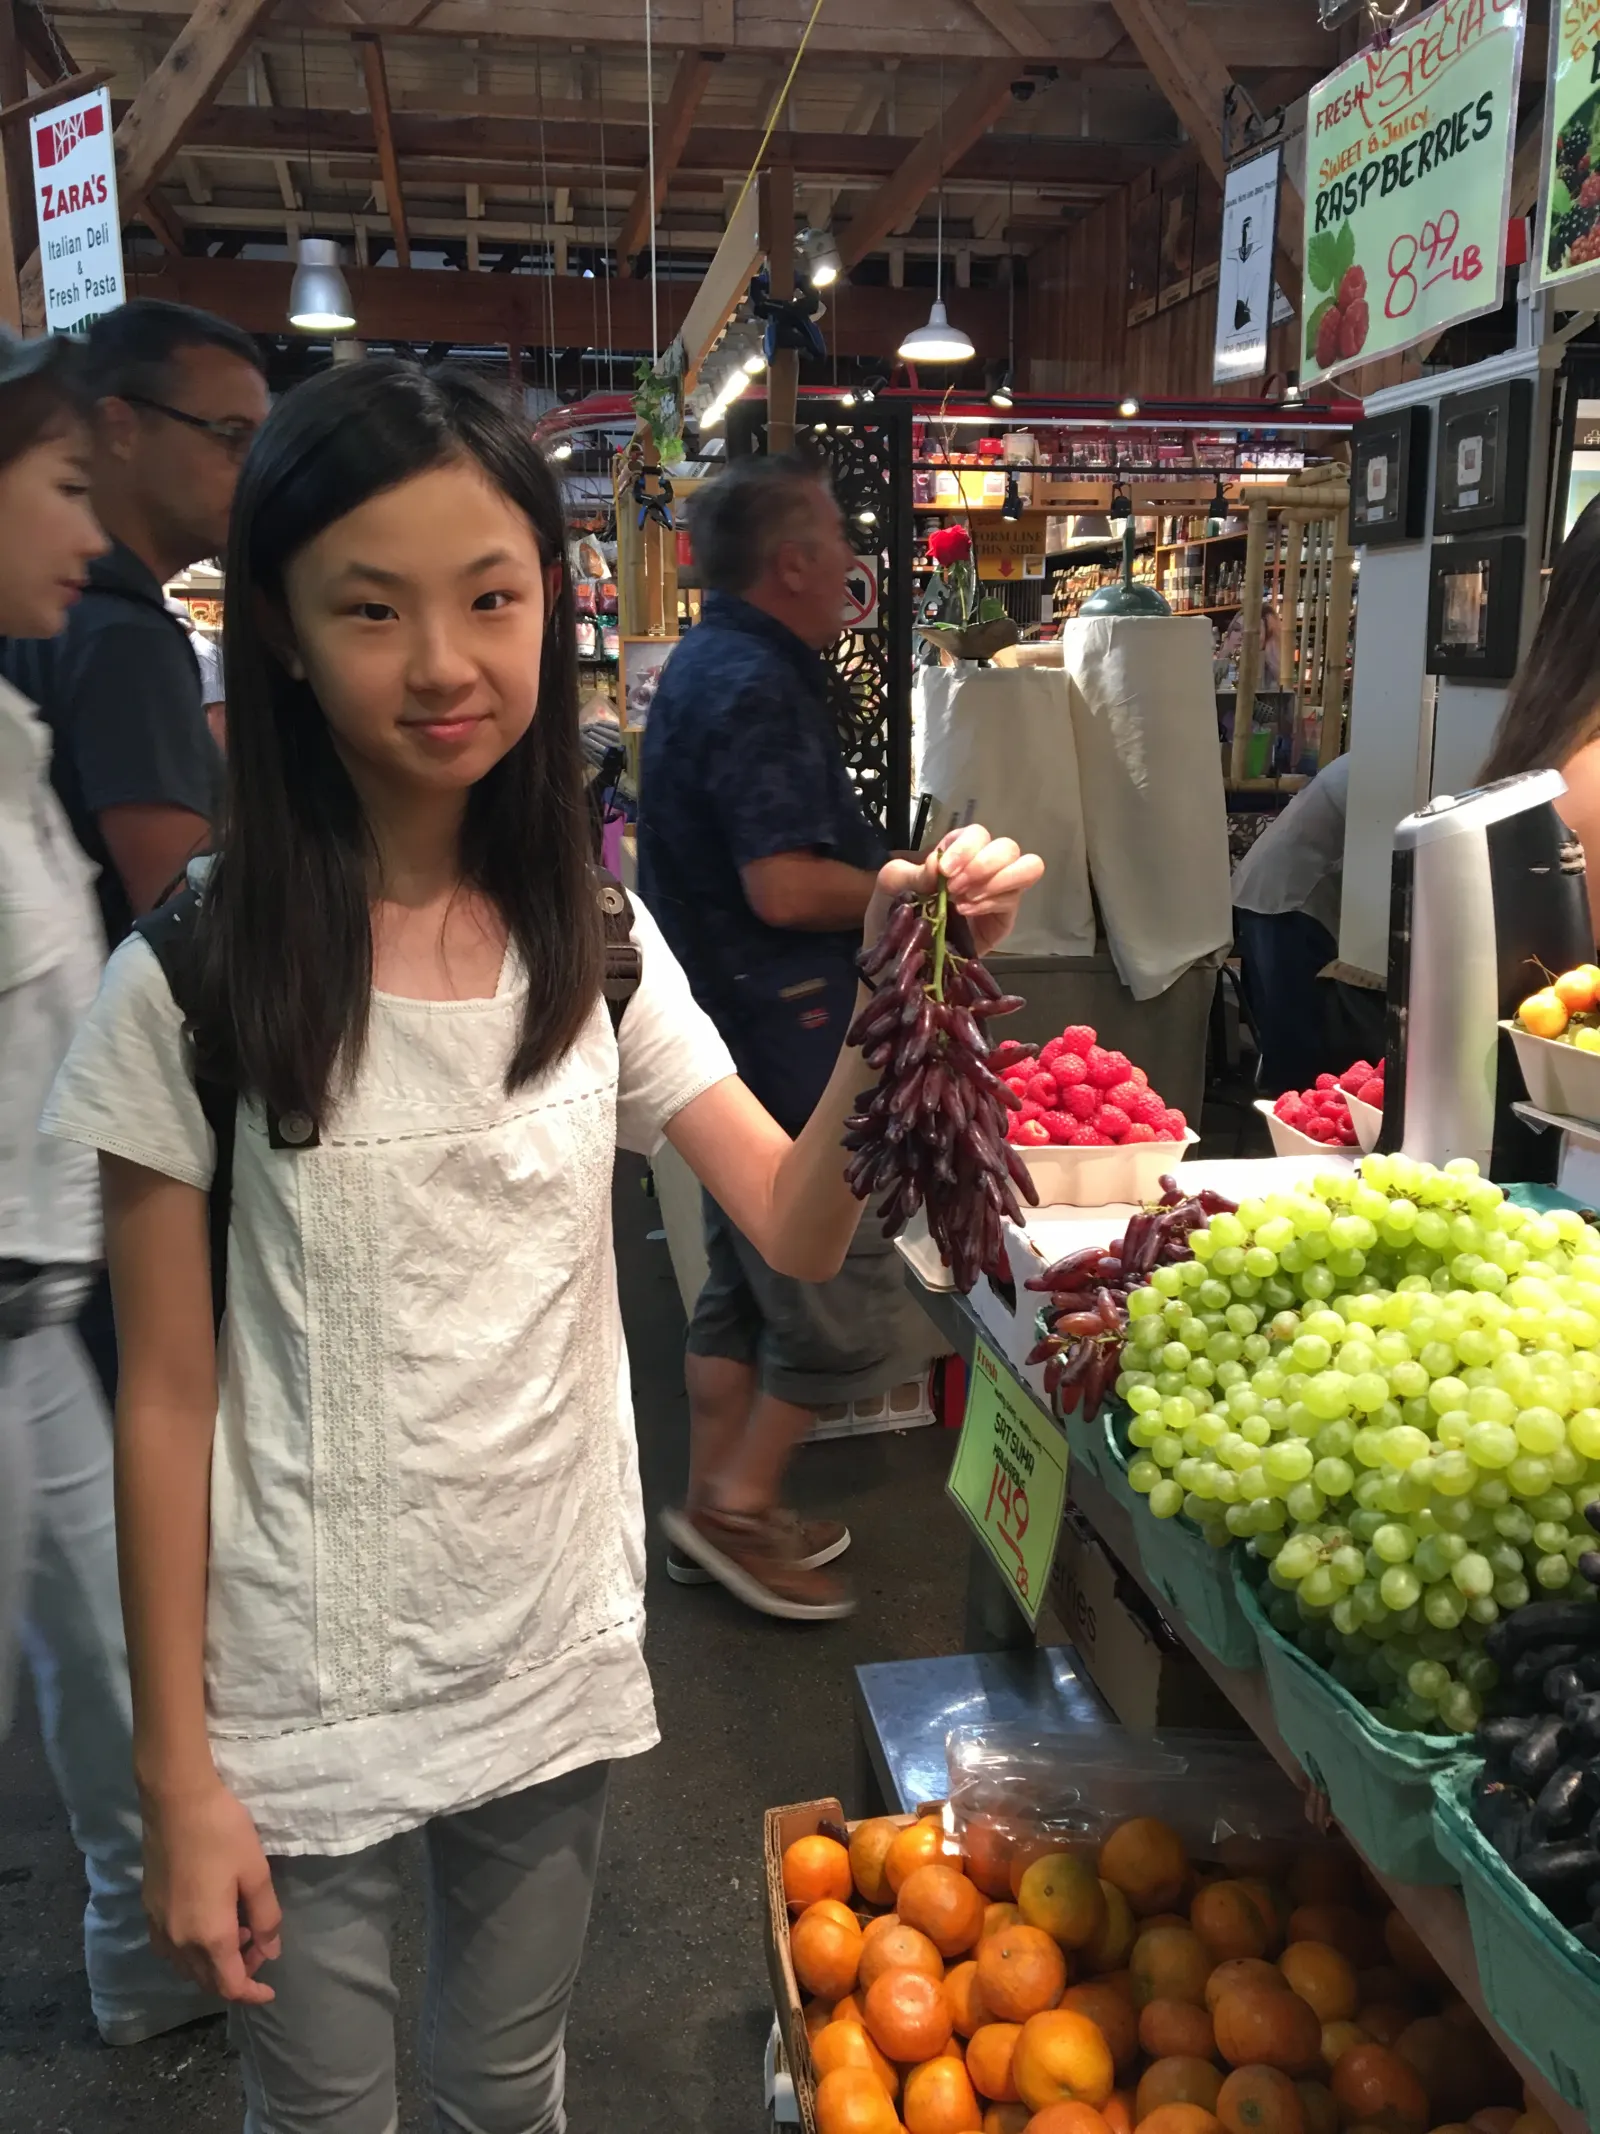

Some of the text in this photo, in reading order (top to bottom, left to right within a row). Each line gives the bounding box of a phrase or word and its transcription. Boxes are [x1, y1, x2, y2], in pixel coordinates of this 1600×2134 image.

[1375, 0, 1515, 108] SPECIA
[1315, 81, 1366, 138] FRESH
[1314, 90, 1494, 234] RASPBERRIES
[1319, 138, 1365, 189] SWEET
[40, 173, 108, 222] ZARA'S
[47, 221, 110, 261] Italian Deli
[77, 260, 84, 276] &
[1452, 244, 1484, 282] LB
[49, 275, 117, 310] Fresh Pasta
[976, 544, 1036, 555] THIS SIDE
[1013, 531, 1044, 542] LINE
[976, 1346, 998, 1383] Fresh
[993, 1411, 1036, 1478] SATSUMA
